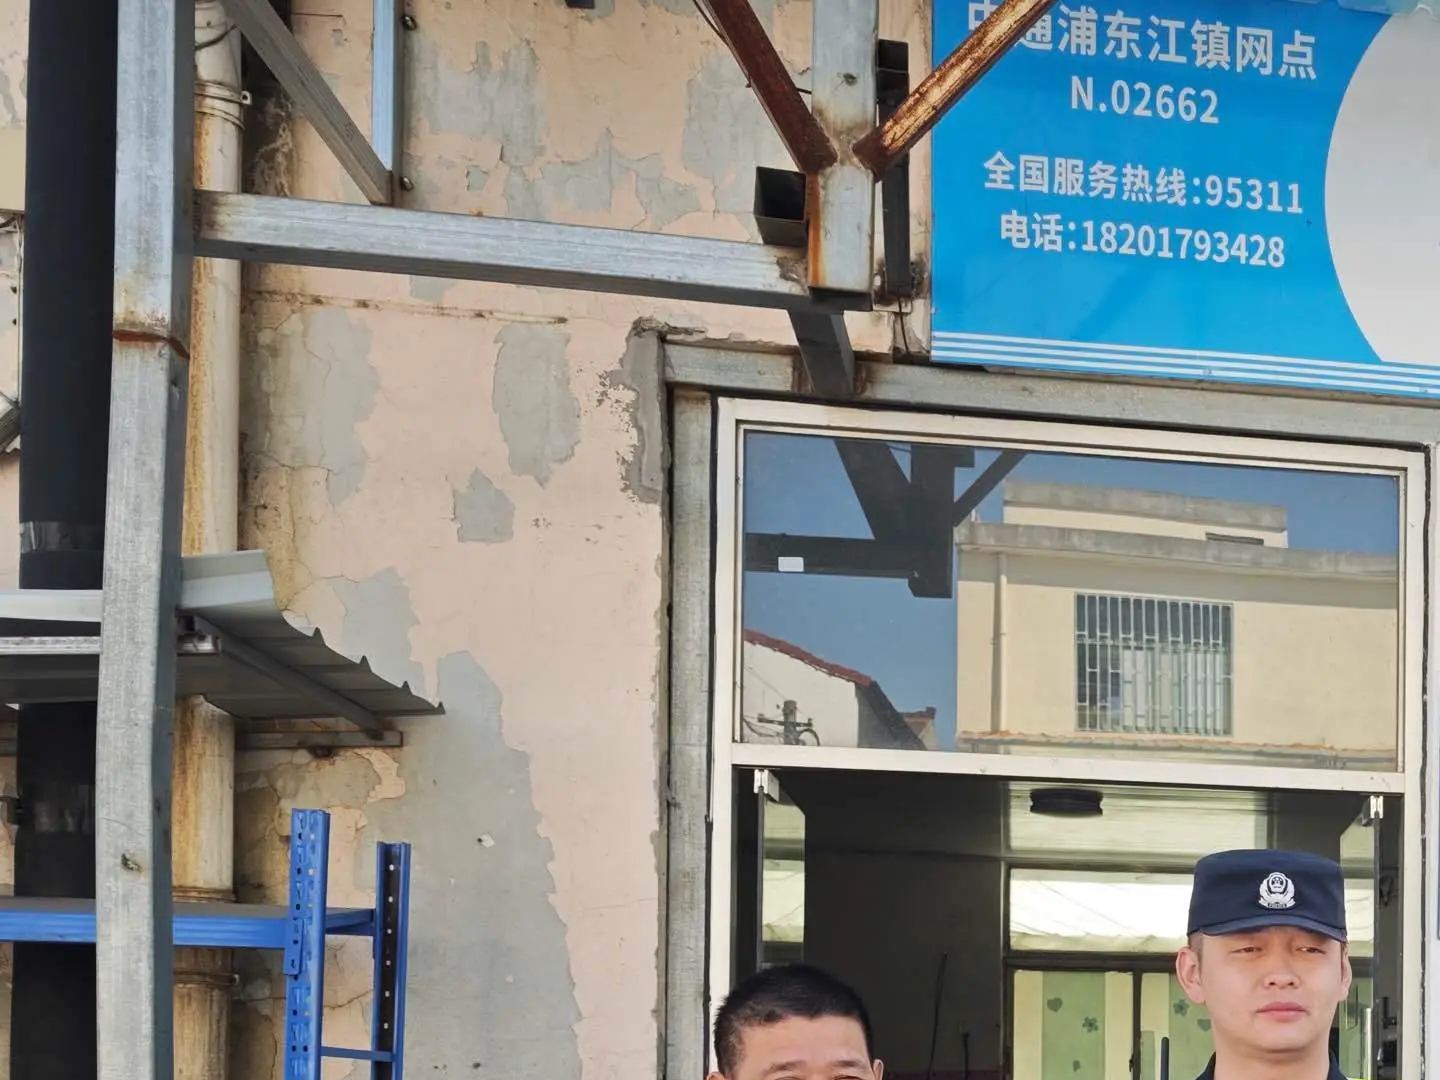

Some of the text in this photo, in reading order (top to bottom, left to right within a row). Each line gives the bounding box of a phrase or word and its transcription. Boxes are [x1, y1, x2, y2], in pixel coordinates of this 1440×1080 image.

[1070, 75, 1220, 124] N.02662
[983, 150, 1304, 215] 全国服务热线:95311
[1000, 208, 1286, 268] 电话:18201793428
